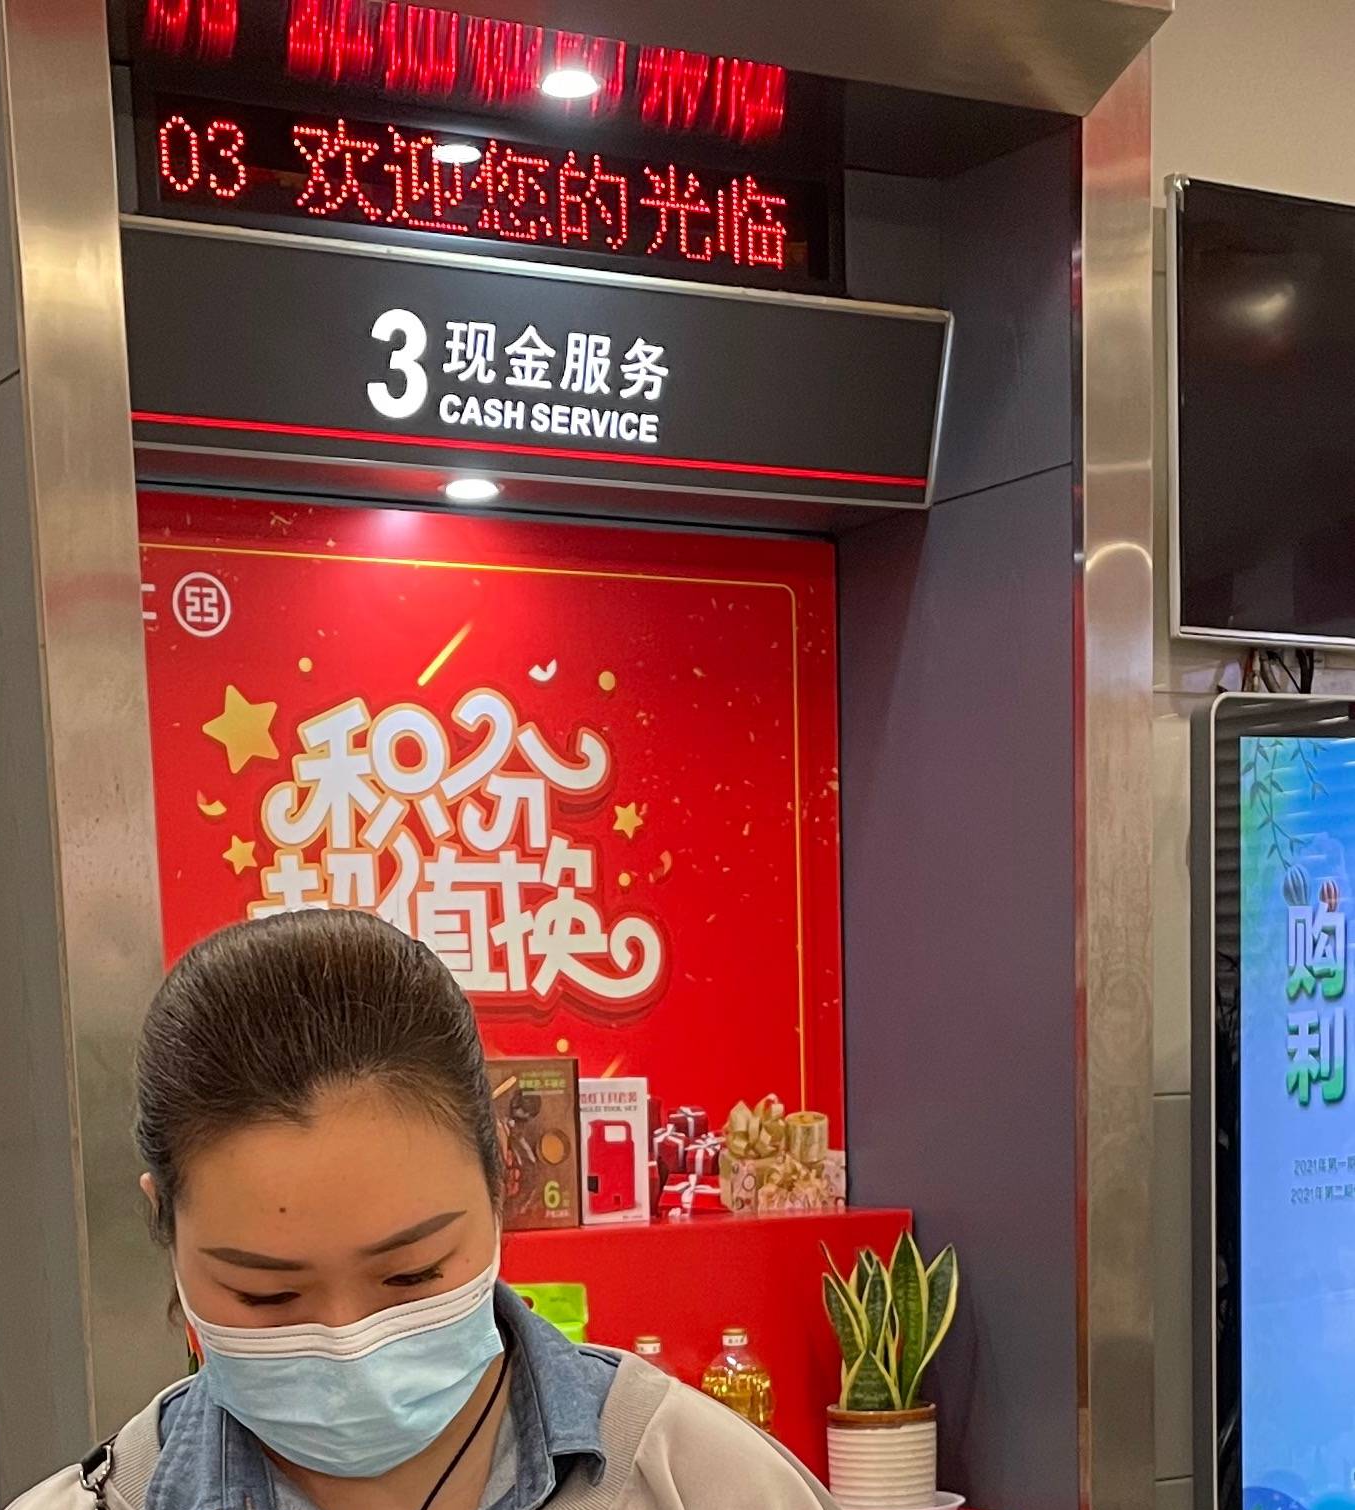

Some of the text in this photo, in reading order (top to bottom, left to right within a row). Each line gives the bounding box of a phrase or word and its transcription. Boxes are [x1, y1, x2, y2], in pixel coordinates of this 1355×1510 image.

[159, 115, 787, 270] 03 欢迎您的光临
[367, 308, 429, 419] 3
[443, 321, 669, 400] 现金服务
[439, 393, 659, 444] CASH SERVICE
[263, 690, 609, 850] 积分
[544, 1180, 561, 1208] 6
